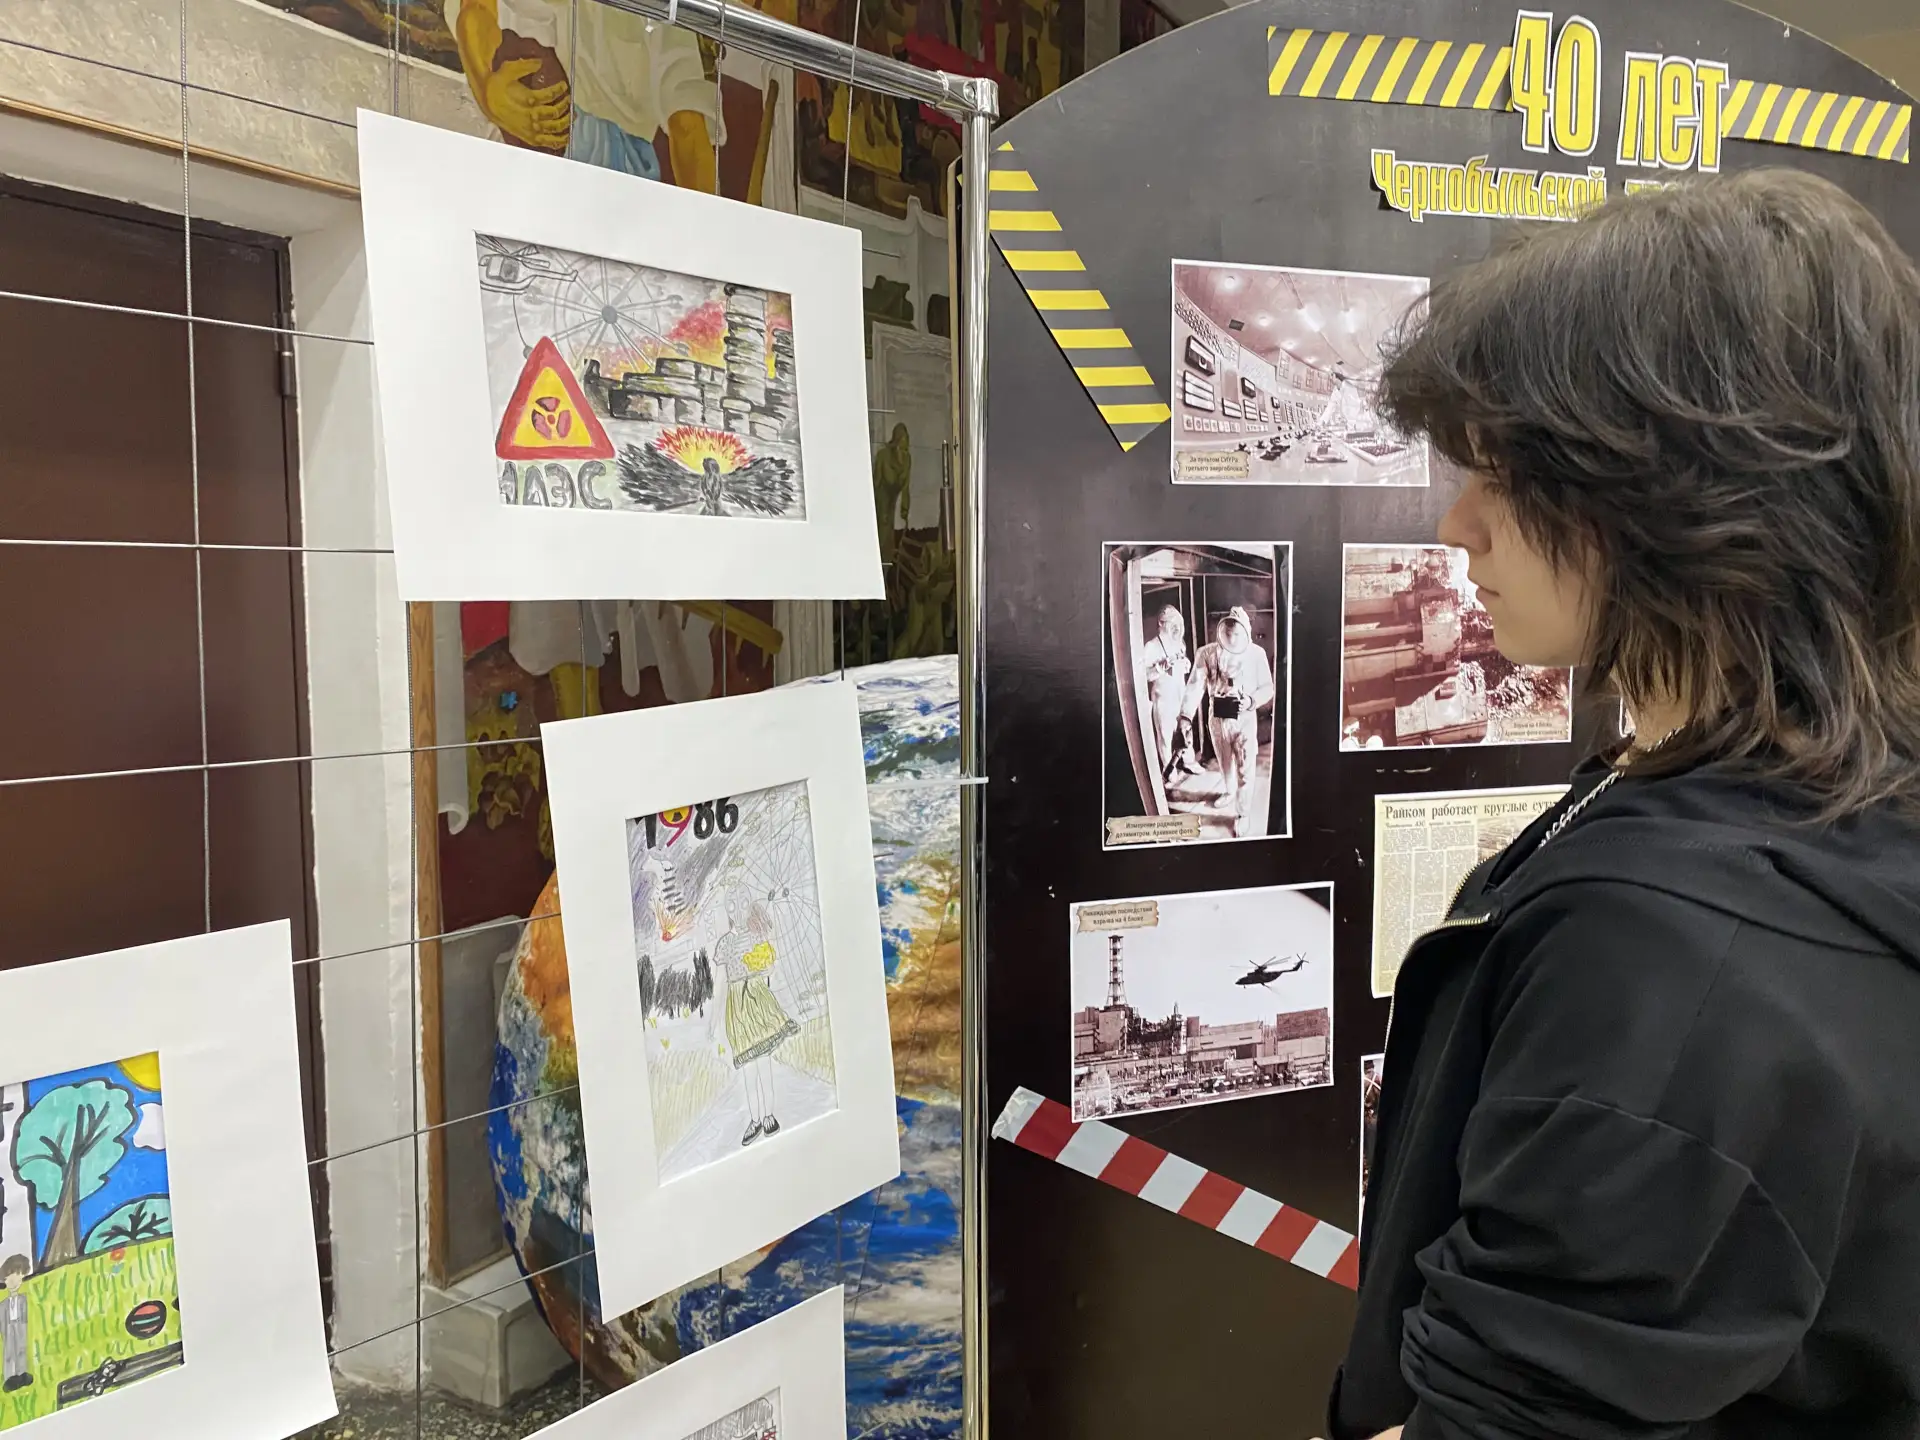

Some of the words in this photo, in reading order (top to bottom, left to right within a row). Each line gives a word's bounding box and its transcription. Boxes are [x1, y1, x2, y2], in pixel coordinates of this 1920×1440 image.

[1511, 12, 1600, 156] 40
[1617, 53, 1728, 171] лет
[1372, 151, 1607, 221] Чернобыльской
[634, 797, 739, 849] 1986
[1385, 805, 1426, 819] Райком
[1431, 803, 1478, 820] работает
[1484, 802, 1528, 816] круглые
